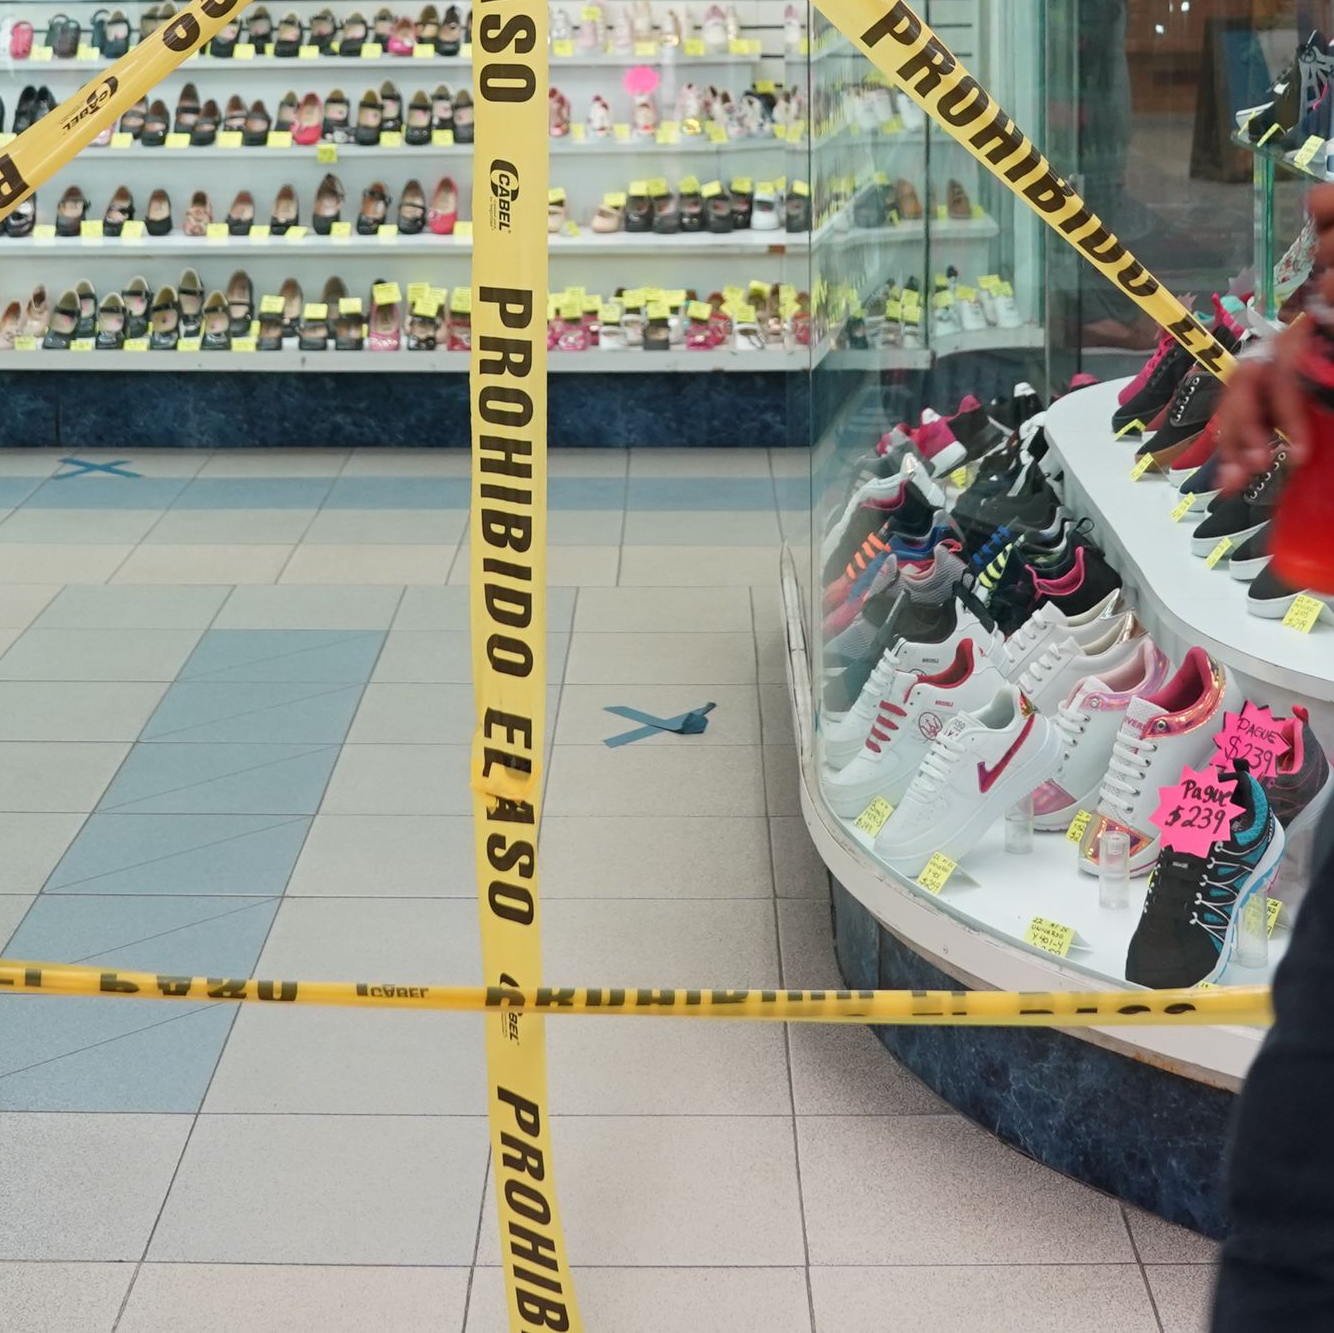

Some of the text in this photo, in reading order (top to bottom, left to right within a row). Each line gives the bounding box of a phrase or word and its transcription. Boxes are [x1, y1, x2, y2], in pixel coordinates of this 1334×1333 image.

[860, 1, 1159, 298] PROHIBIDO
[478, 285, 534, 679] PROHIBIDO
[1165, 804, 1226, 835] $239
[498, 1086, 569, 1333] PROHIB
